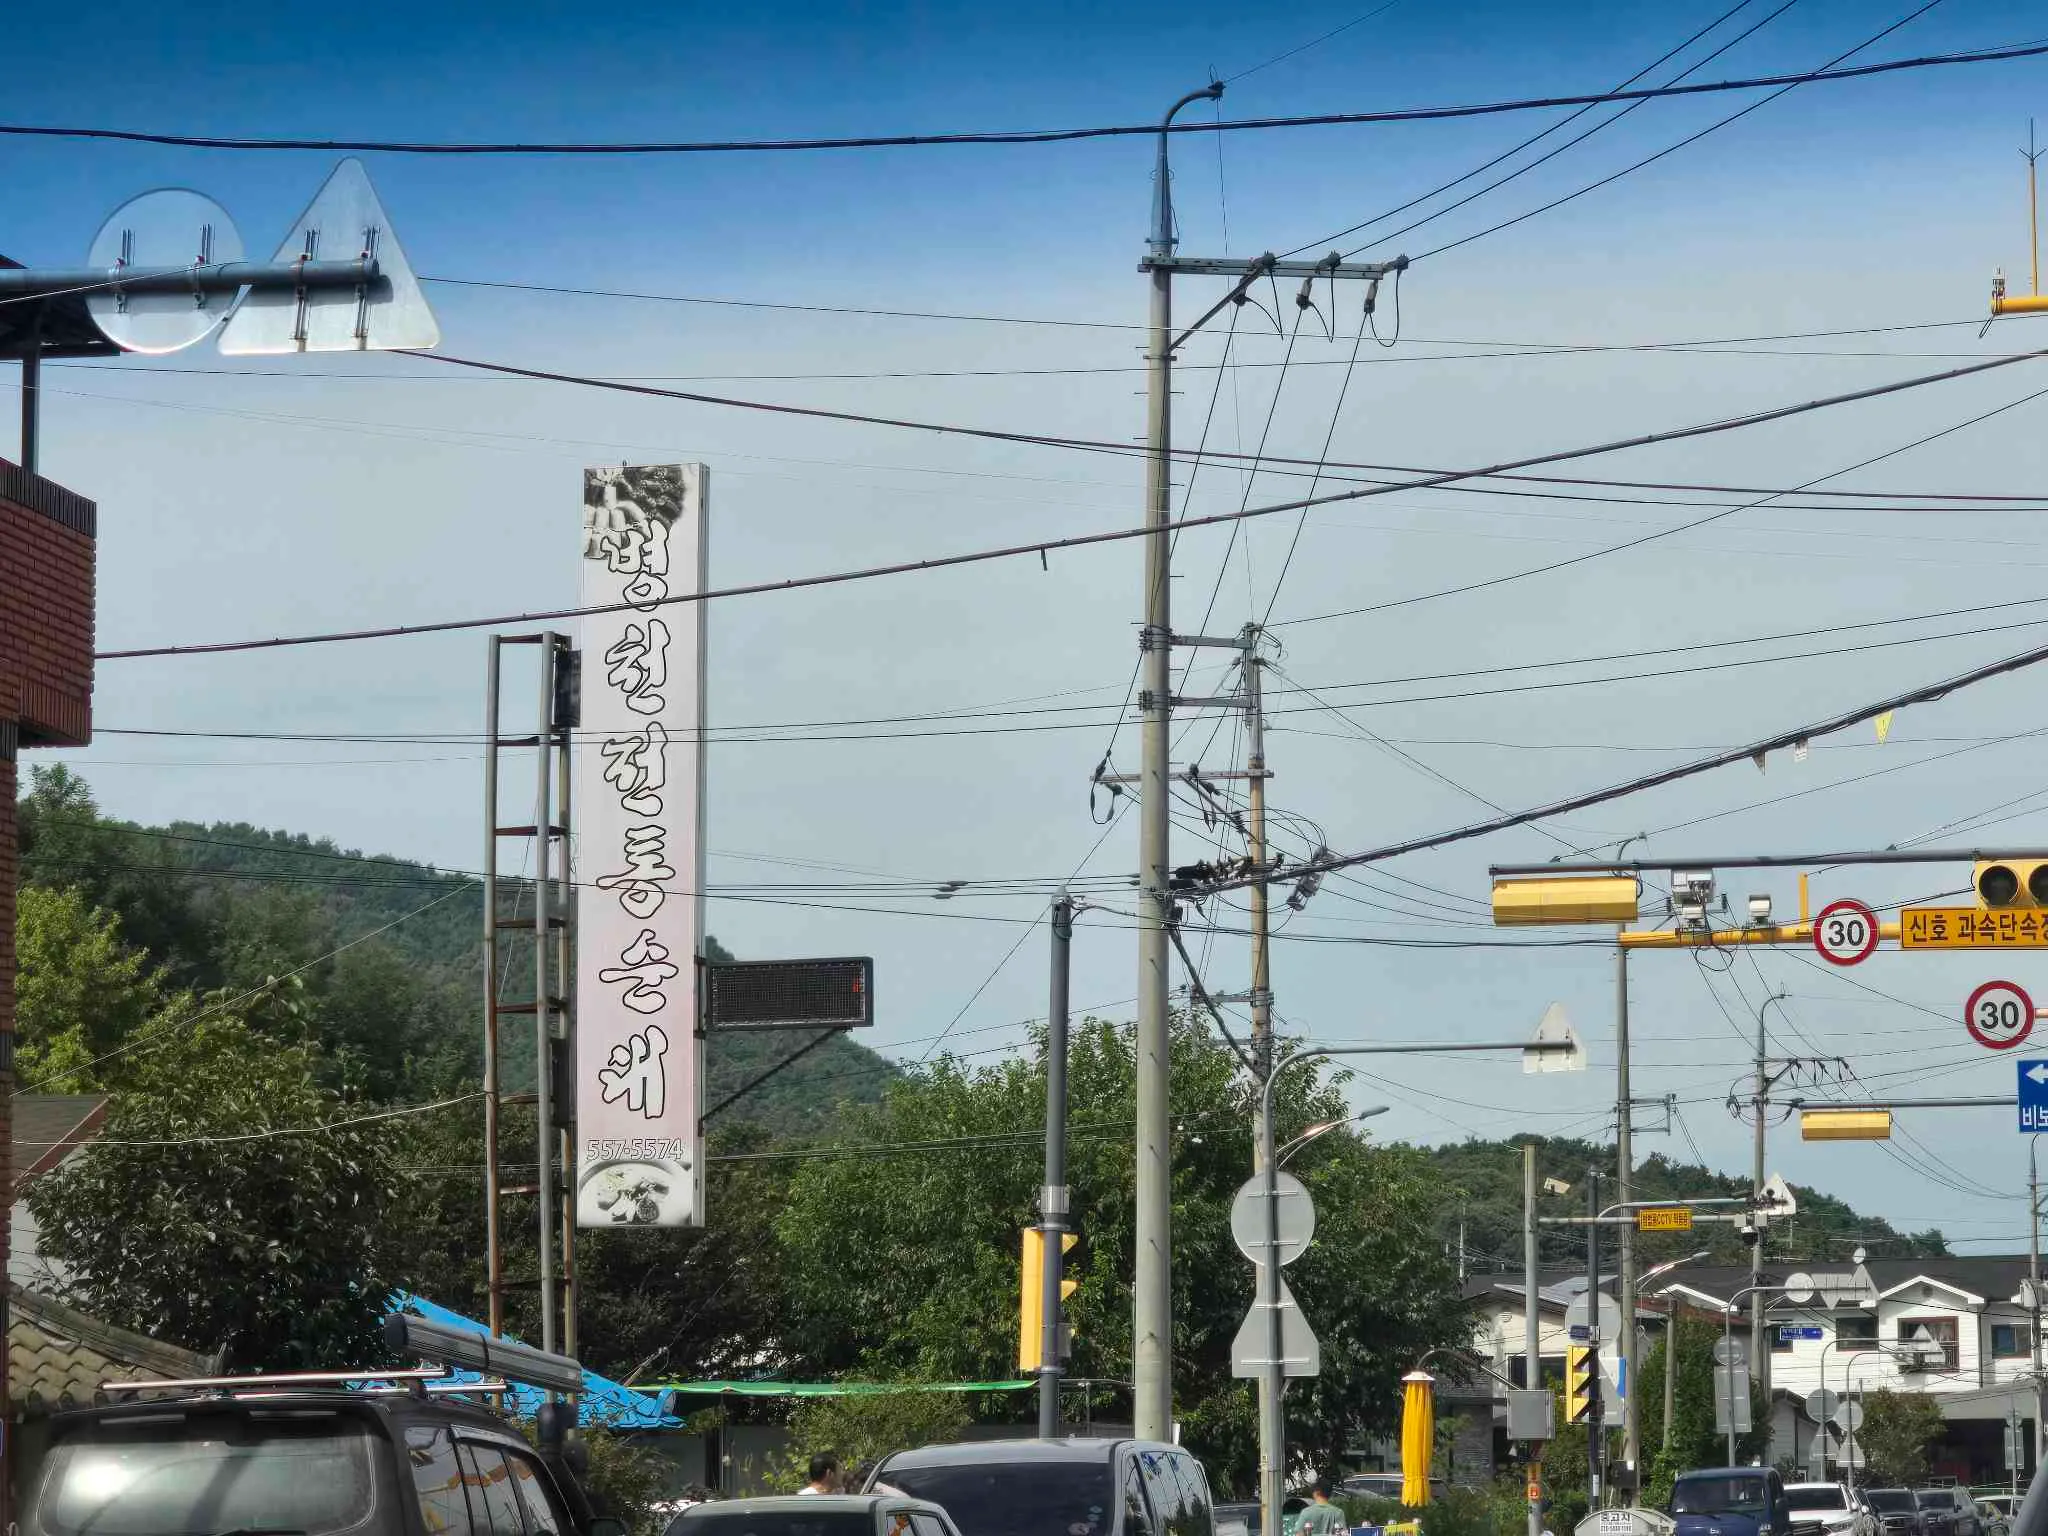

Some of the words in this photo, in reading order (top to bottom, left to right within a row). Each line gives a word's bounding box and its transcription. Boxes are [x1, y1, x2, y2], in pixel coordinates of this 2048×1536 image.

[1828, 919, 1864, 947] 30
[1910, 913, 1949, 943] 신호
[1980, 1001, 2019, 1029] 30
[587, 1138, 684, 1161] 557-5574
